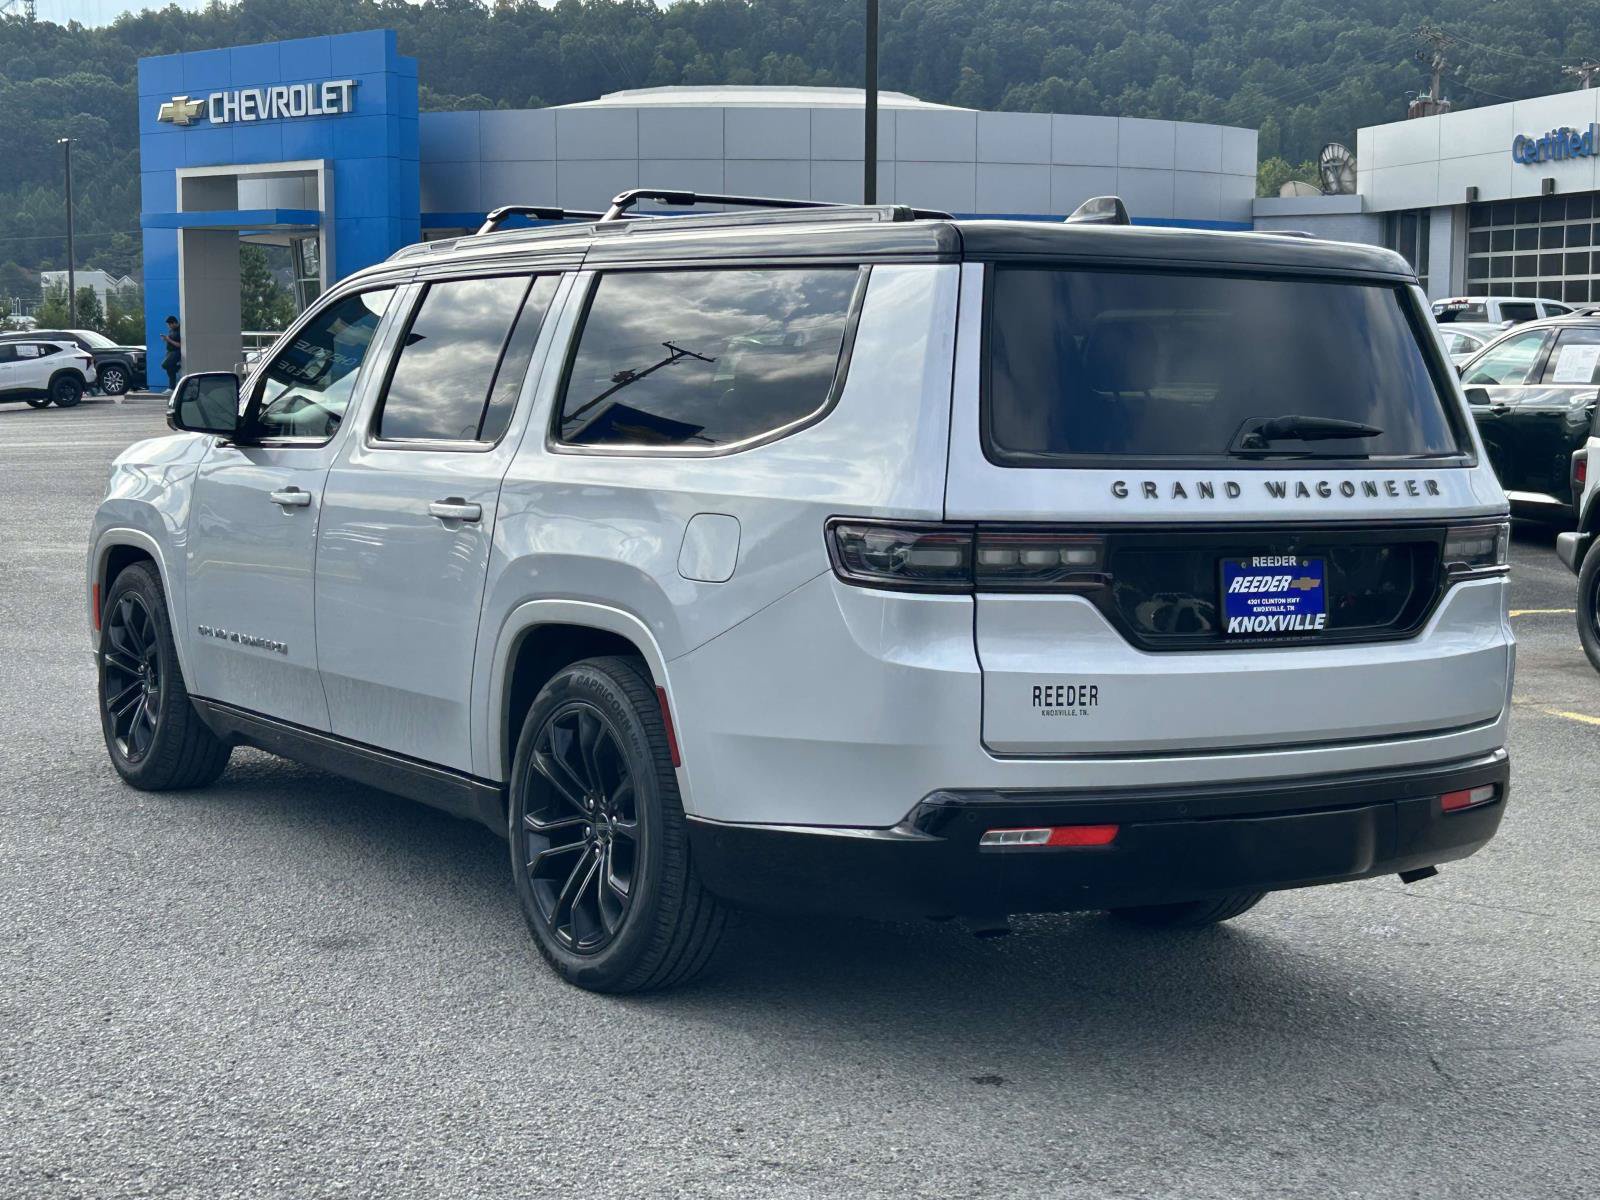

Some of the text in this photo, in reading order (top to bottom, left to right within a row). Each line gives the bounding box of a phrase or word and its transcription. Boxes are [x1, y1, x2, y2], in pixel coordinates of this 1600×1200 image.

[208, 79, 356, 124] CHEVROLET
[1512, 122, 1599, 164] Certified
[1111, 479, 1441, 499] GRAND WAGONEER
[1252, 555, 1297, 567] REEDER
[1228, 575, 1292, 593] REEDER
[1261, 597, 1287, 605] CLINTON
[1227, 613, 1326, 633] KNOXVILLE
[575, 675, 633, 733] CAPRICORN
[1032, 685, 1099, 707] REEDER
